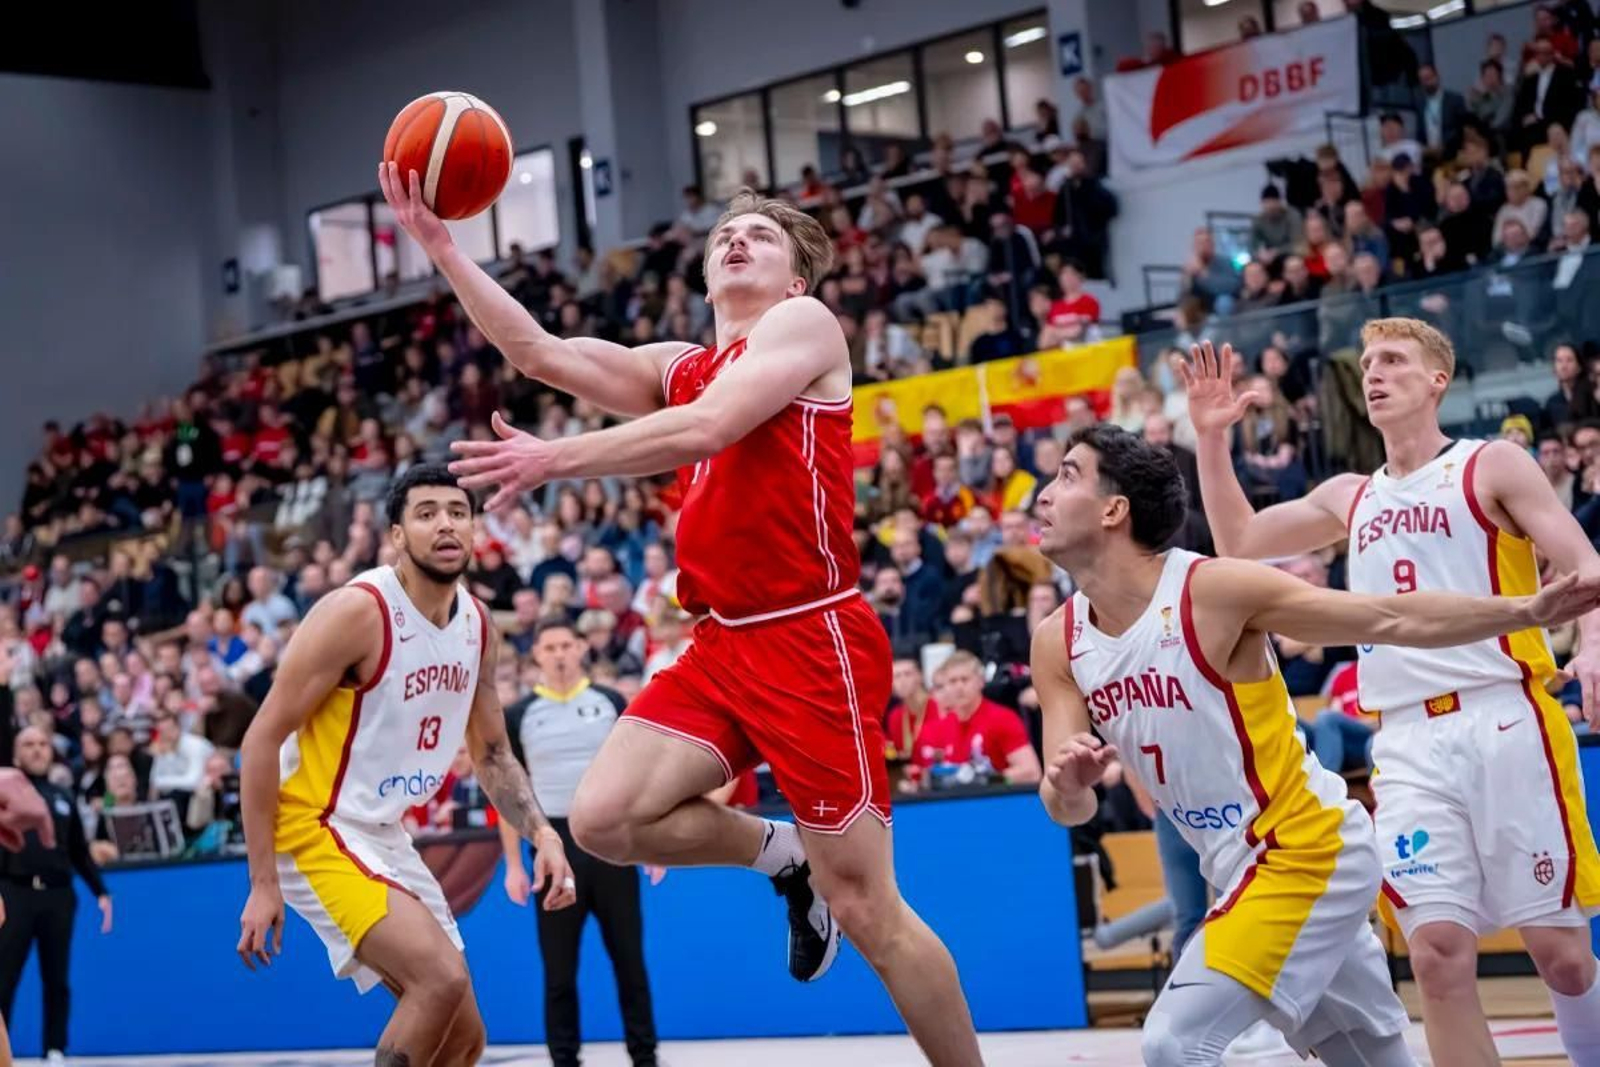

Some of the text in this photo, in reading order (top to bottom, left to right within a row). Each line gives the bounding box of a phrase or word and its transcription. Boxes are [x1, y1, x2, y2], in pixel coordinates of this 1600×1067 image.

[1238, 56, 1325, 102] DBBF
[1358, 502, 1452, 554] ESPAÑA
[1393, 559, 1417, 594] 9
[403, 661, 470, 702] ESPAÑA
[416, 715, 442, 751] 13
[1140, 744, 1166, 785] 7
